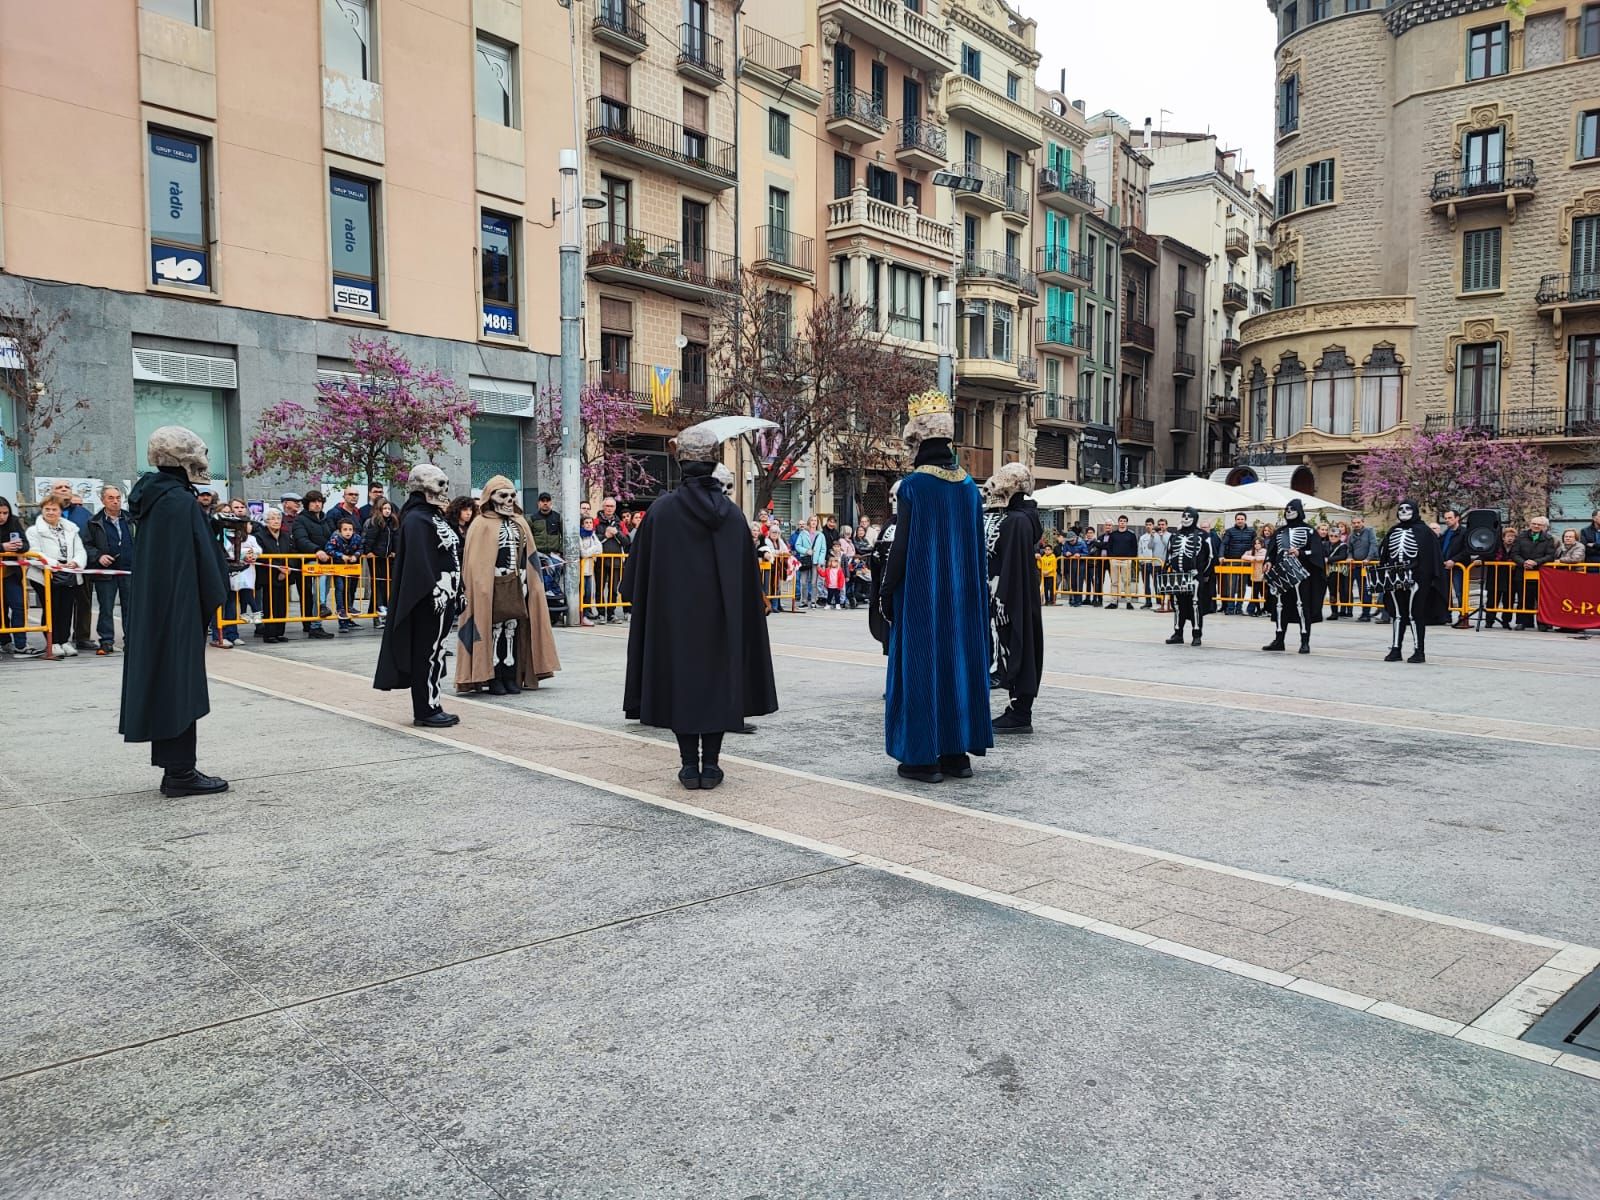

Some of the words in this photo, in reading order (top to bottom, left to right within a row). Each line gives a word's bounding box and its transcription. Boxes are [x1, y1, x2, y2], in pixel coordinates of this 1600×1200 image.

[169, 181, 183, 219] ràdio
[344, 218, 356, 252] ràdio
[155, 256, 203, 281] 40
[337, 291, 369, 307] SER
[483, 312, 508, 330] M80
[1561, 598, 1600, 616] S.P.
